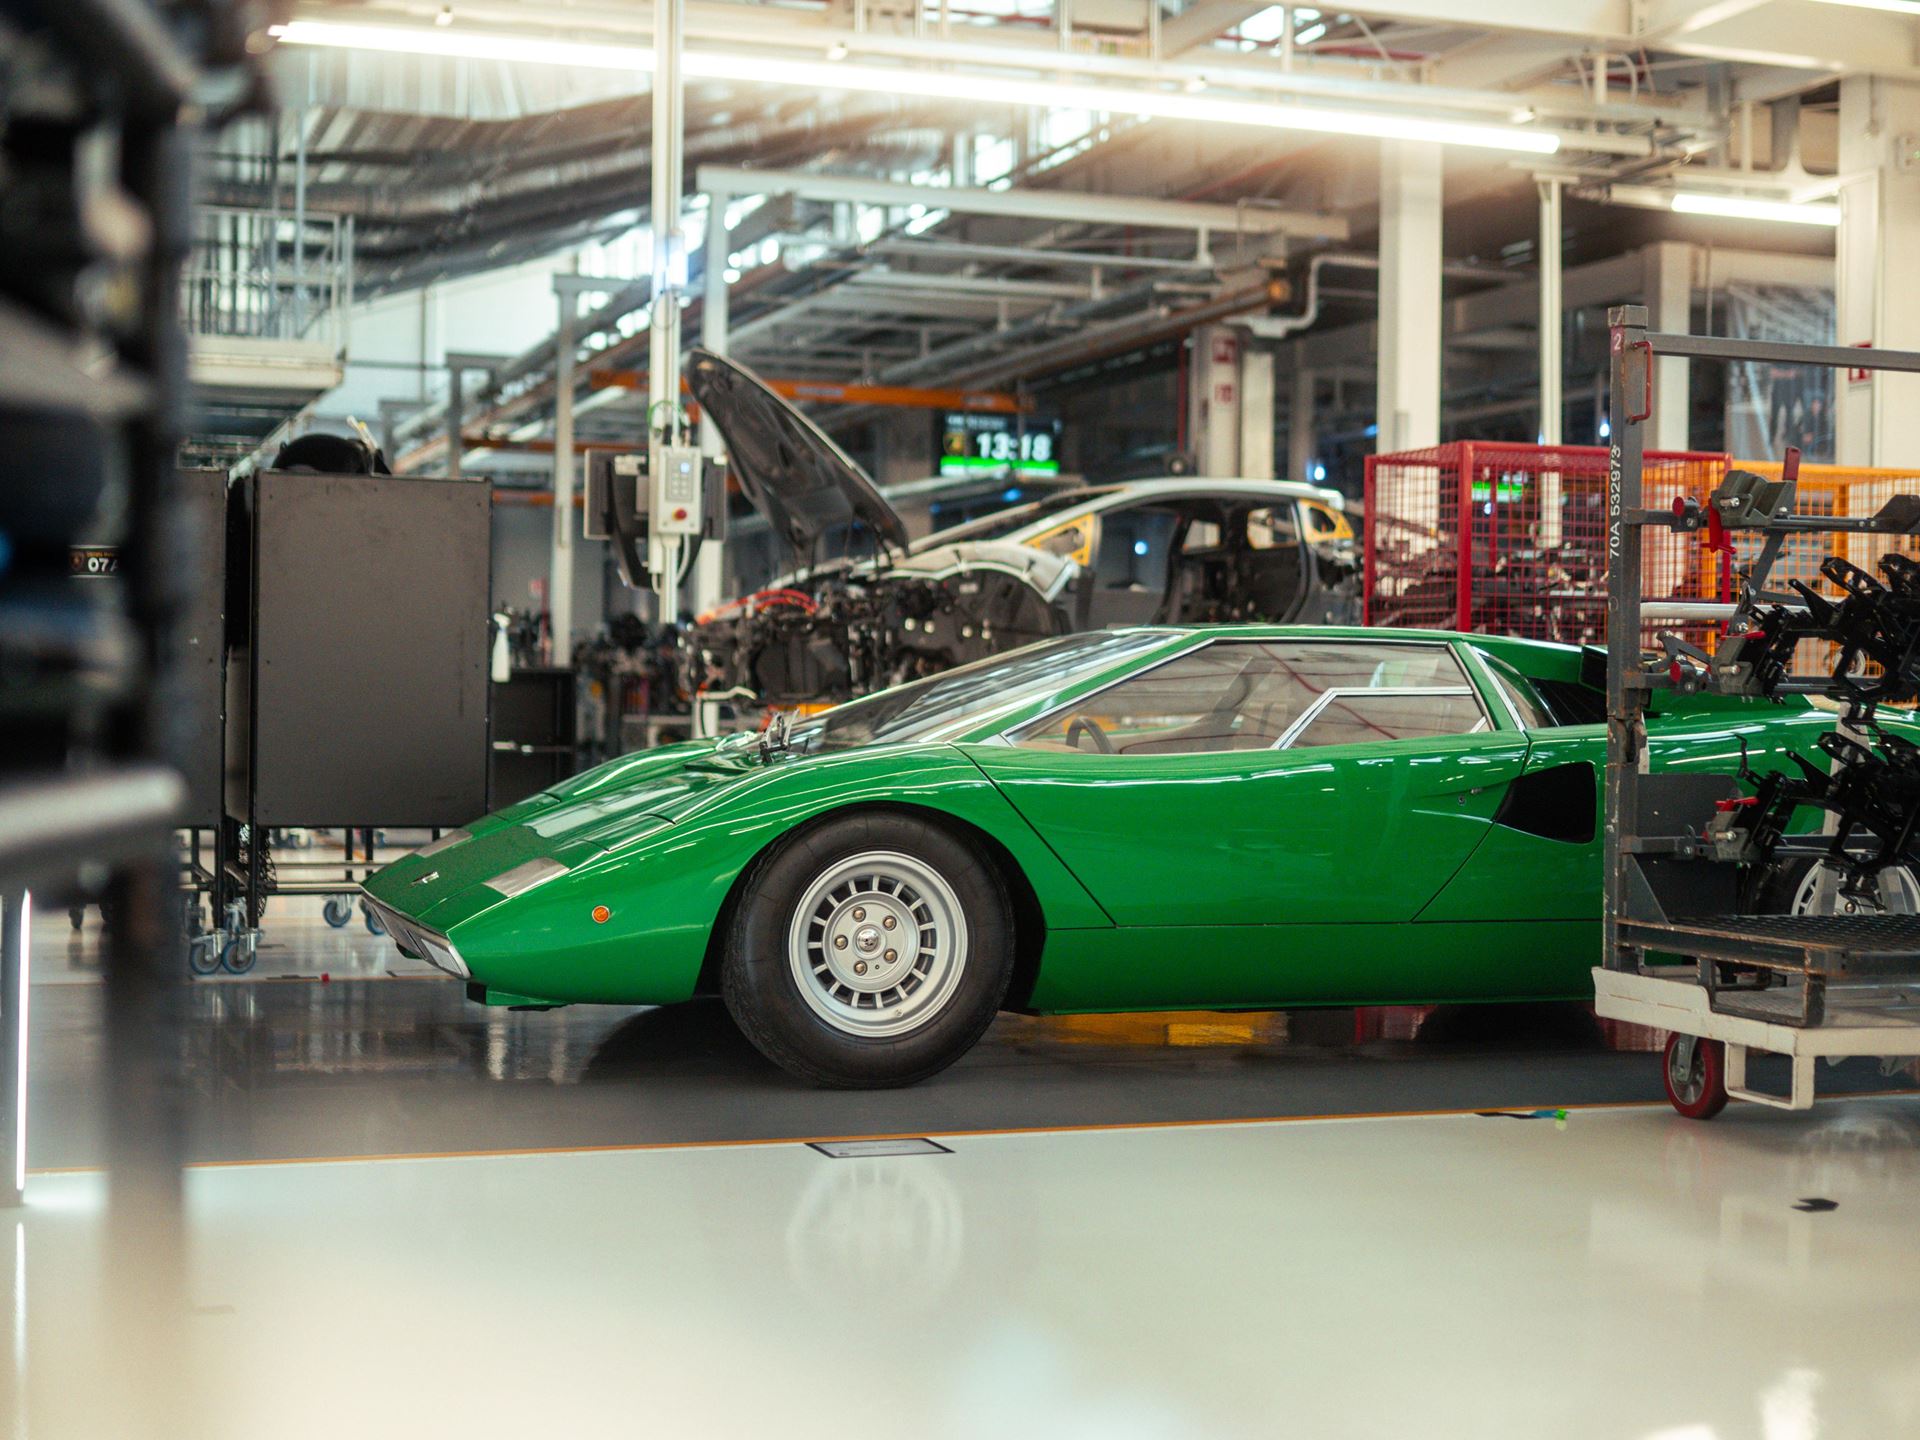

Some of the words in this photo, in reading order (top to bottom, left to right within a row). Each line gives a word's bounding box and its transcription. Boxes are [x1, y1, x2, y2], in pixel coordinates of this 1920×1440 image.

[1613, 333, 1622, 351] 2
[976, 432, 1052, 462] 13:18
[1610, 445, 1622, 517] 532973
[1609, 521, 1621, 560] 70A
